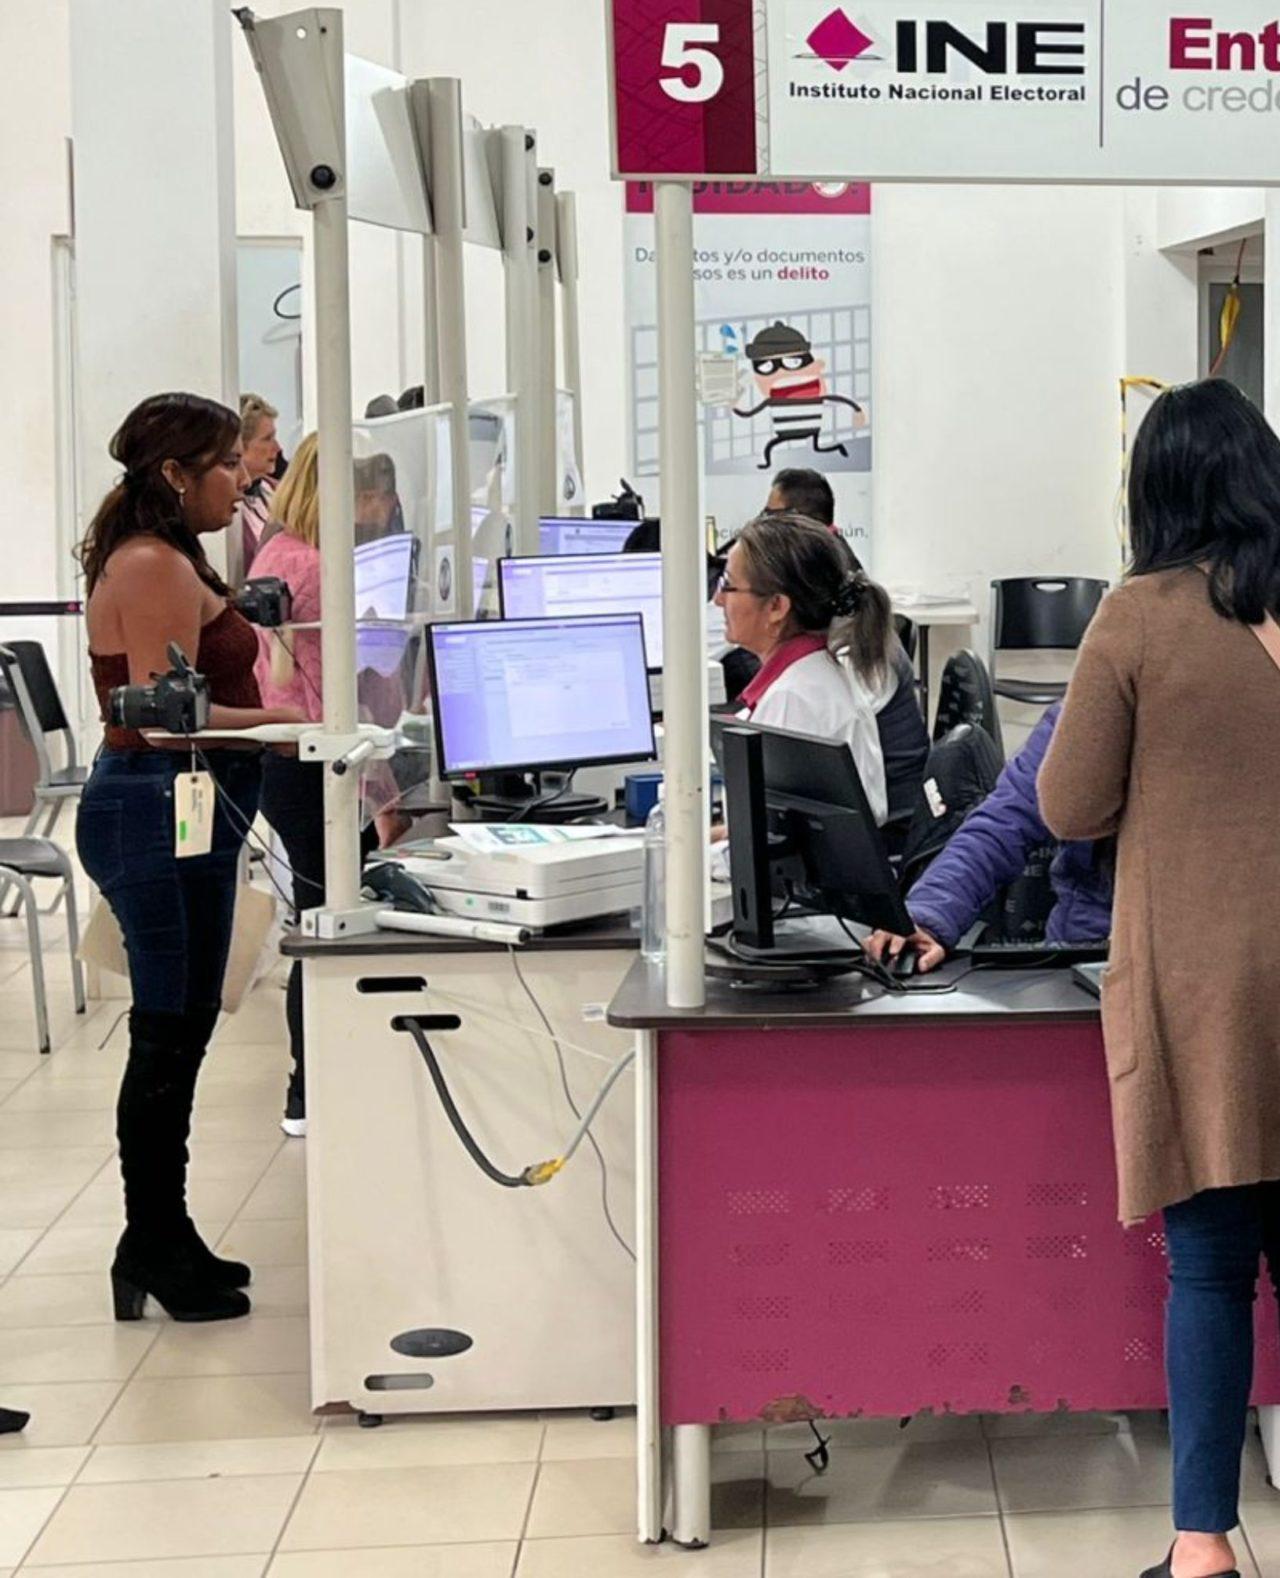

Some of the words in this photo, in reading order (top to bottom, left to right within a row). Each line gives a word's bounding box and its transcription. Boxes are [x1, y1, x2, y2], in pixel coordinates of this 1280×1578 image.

[895, 20, 1085, 75] INE
[658, 23, 724, 103] 5
[789, 82, 881, 100] Instituto
[888, 83, 983, 101] Nacional
[990, 83, 1085, 102] Electoral
[1116, 77, 1169, 111] de
[724, 248, 752, 265] y/o
[757, 248, 865, 263] documentos
[727, 268, 746, 280] es
[751, 268, 773, 280] un
[777, 265, 830, 280] delito
